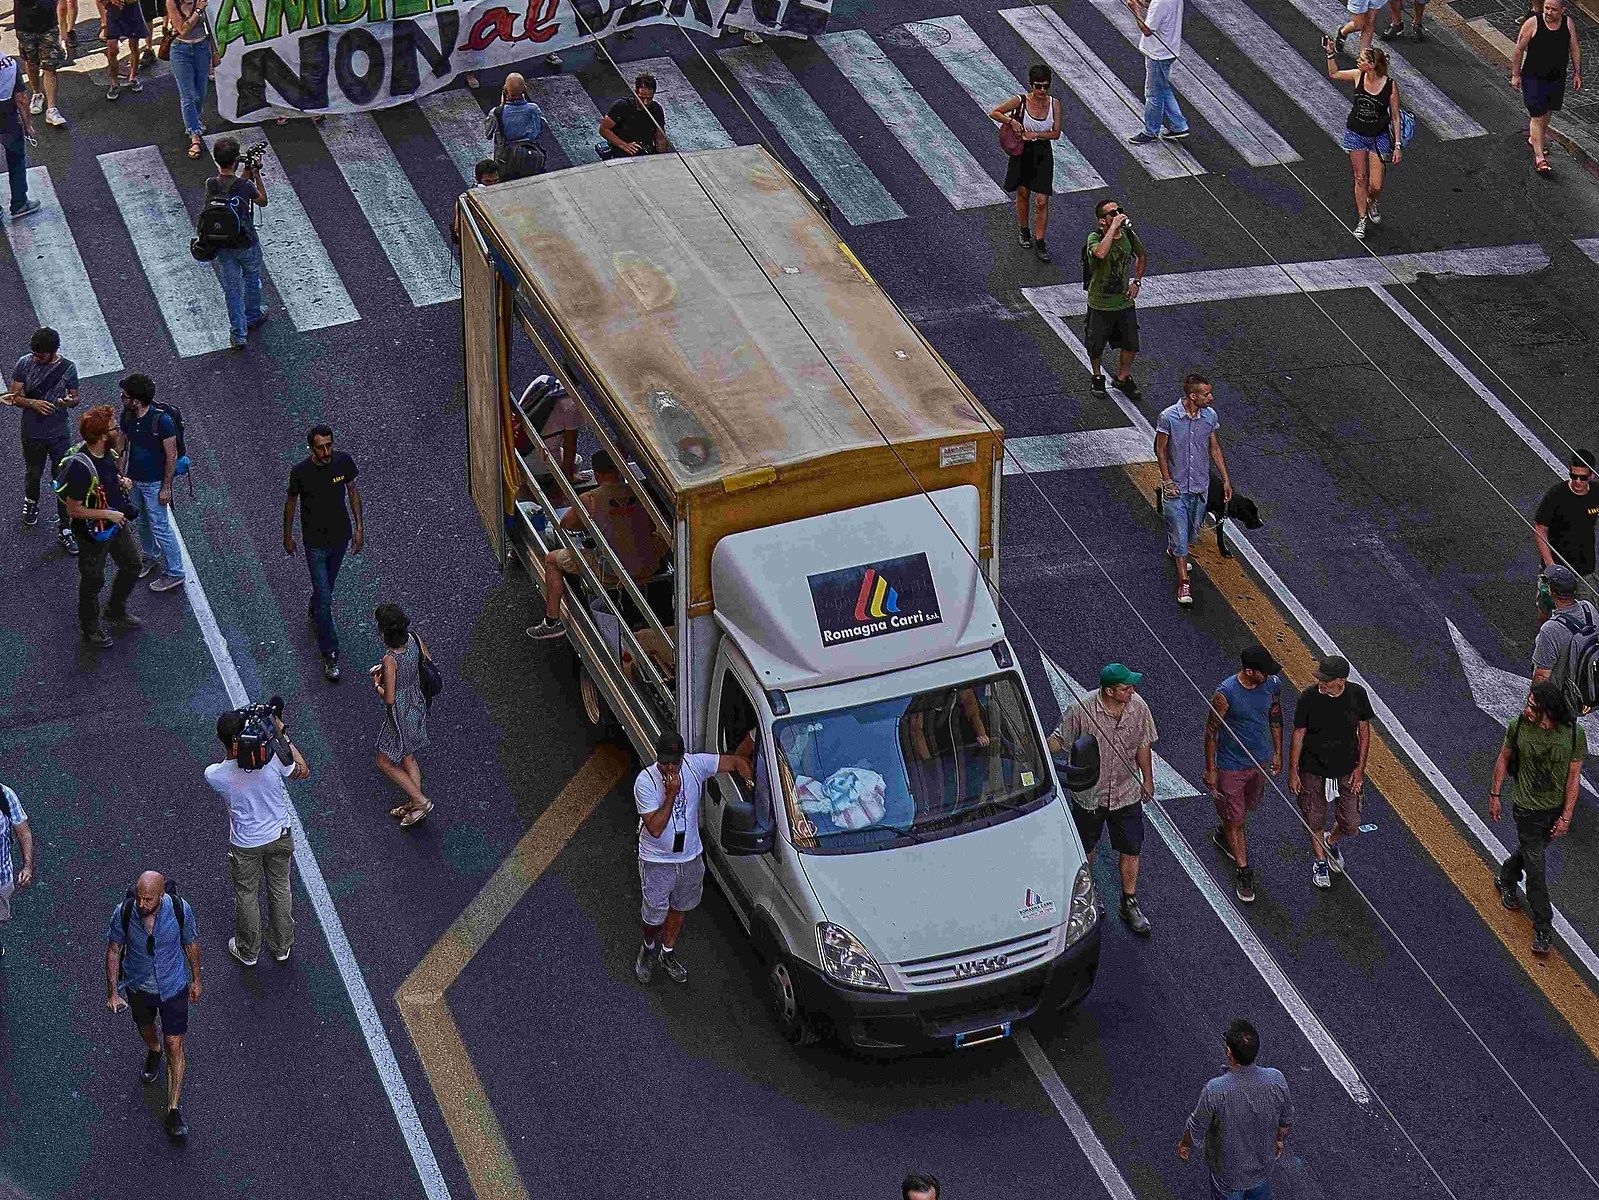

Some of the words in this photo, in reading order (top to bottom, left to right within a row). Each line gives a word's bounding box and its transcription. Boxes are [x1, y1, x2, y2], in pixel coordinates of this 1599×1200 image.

[236, 9, 460, 118] NON
[823, 621, 888, 642] Romagna
[890, 610, 924, 628] Carri
[953, 953, 1008, 977] IVECO
